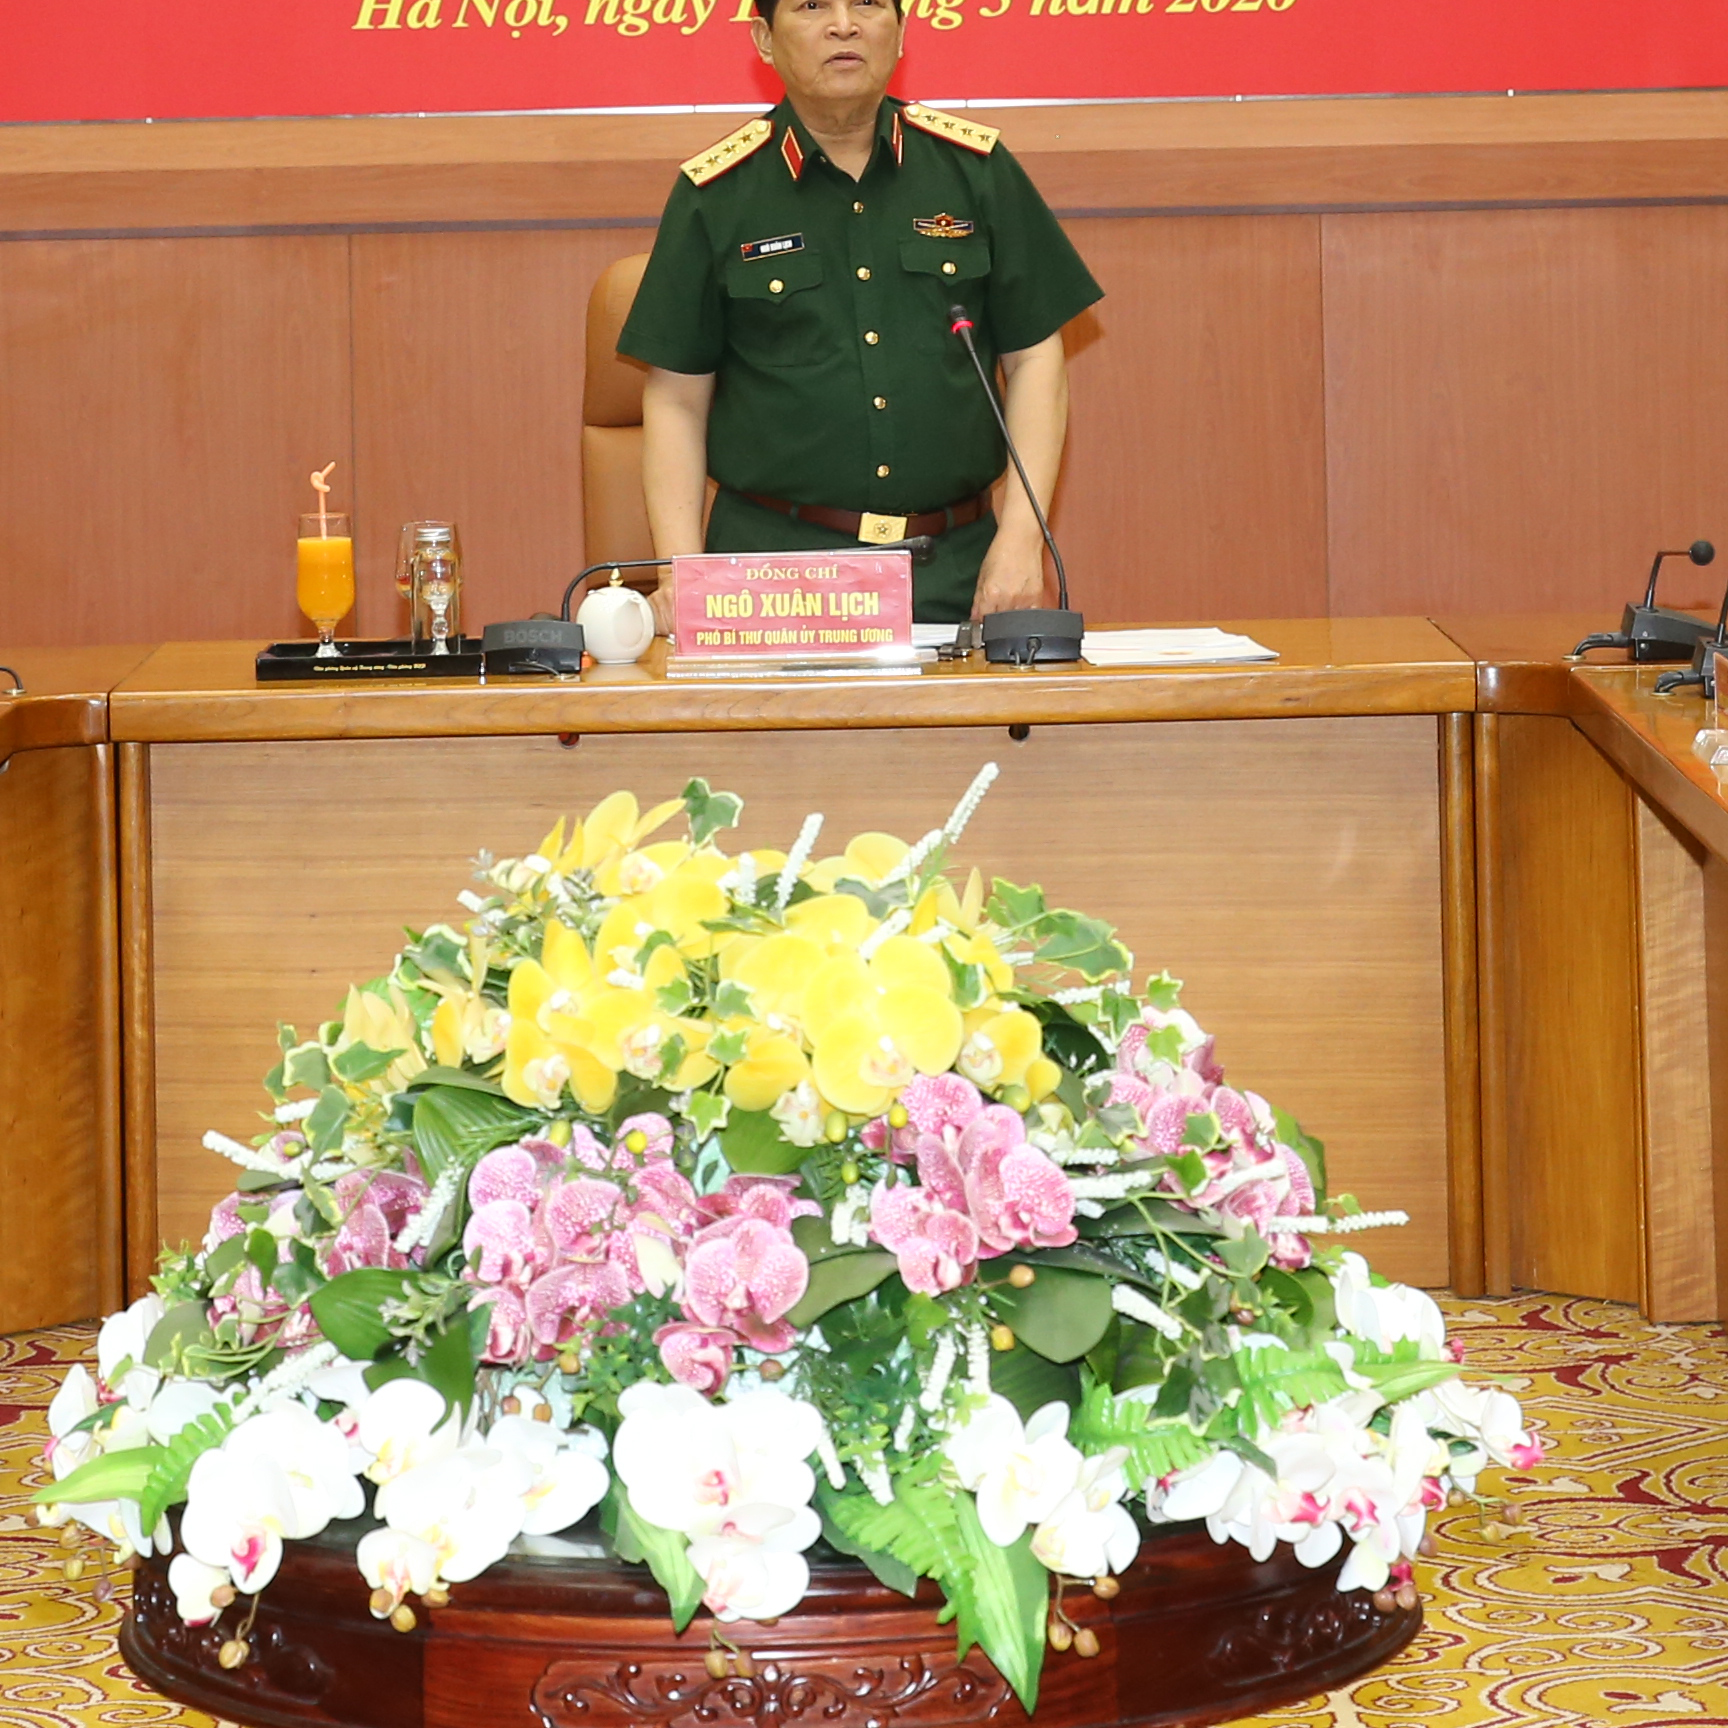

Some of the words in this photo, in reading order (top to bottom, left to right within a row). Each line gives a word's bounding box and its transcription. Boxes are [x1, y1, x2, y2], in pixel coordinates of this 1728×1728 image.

[804, 563, 839, 580] CHÍ
[705, 589, 754, 618] NGÔ
[759, 588, 822, 618] XUÂN
[828, 591, 879, 622] LỊCH
[503, 629, 563, 644] BOSCH
[696, 628, 721, 646] PHÓ
[723, 628, 737, 645] BÍ
[739, 629, 763, 645] THƯ
[764, 628, 798, 646] QUÂN
[800, 624, 817, 645] ỦY
[818, 628, 858, 645] TRUNG
[860, 627, 894, 644] ƯƠNG
